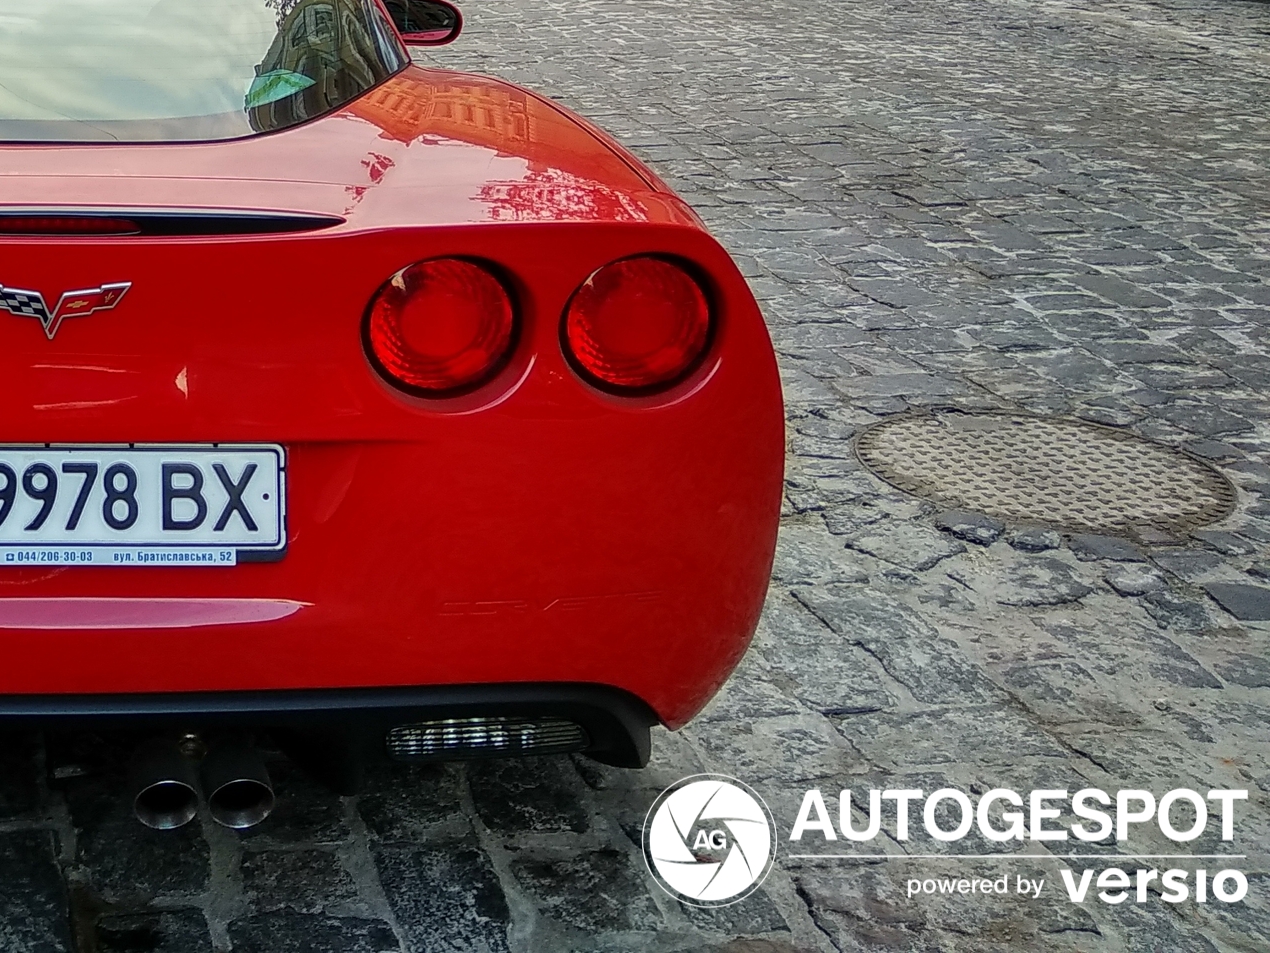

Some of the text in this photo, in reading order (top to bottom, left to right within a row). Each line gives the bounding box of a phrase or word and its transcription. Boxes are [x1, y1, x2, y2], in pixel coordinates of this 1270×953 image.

[162, 462, 259, 532] BX
[17, 551, 93, 563] 044/206-30-03
[113, 553, 135, 564] вул.
[137, 550, 217, 563] Братиславська,
[220, 551, 232, 562] 52
